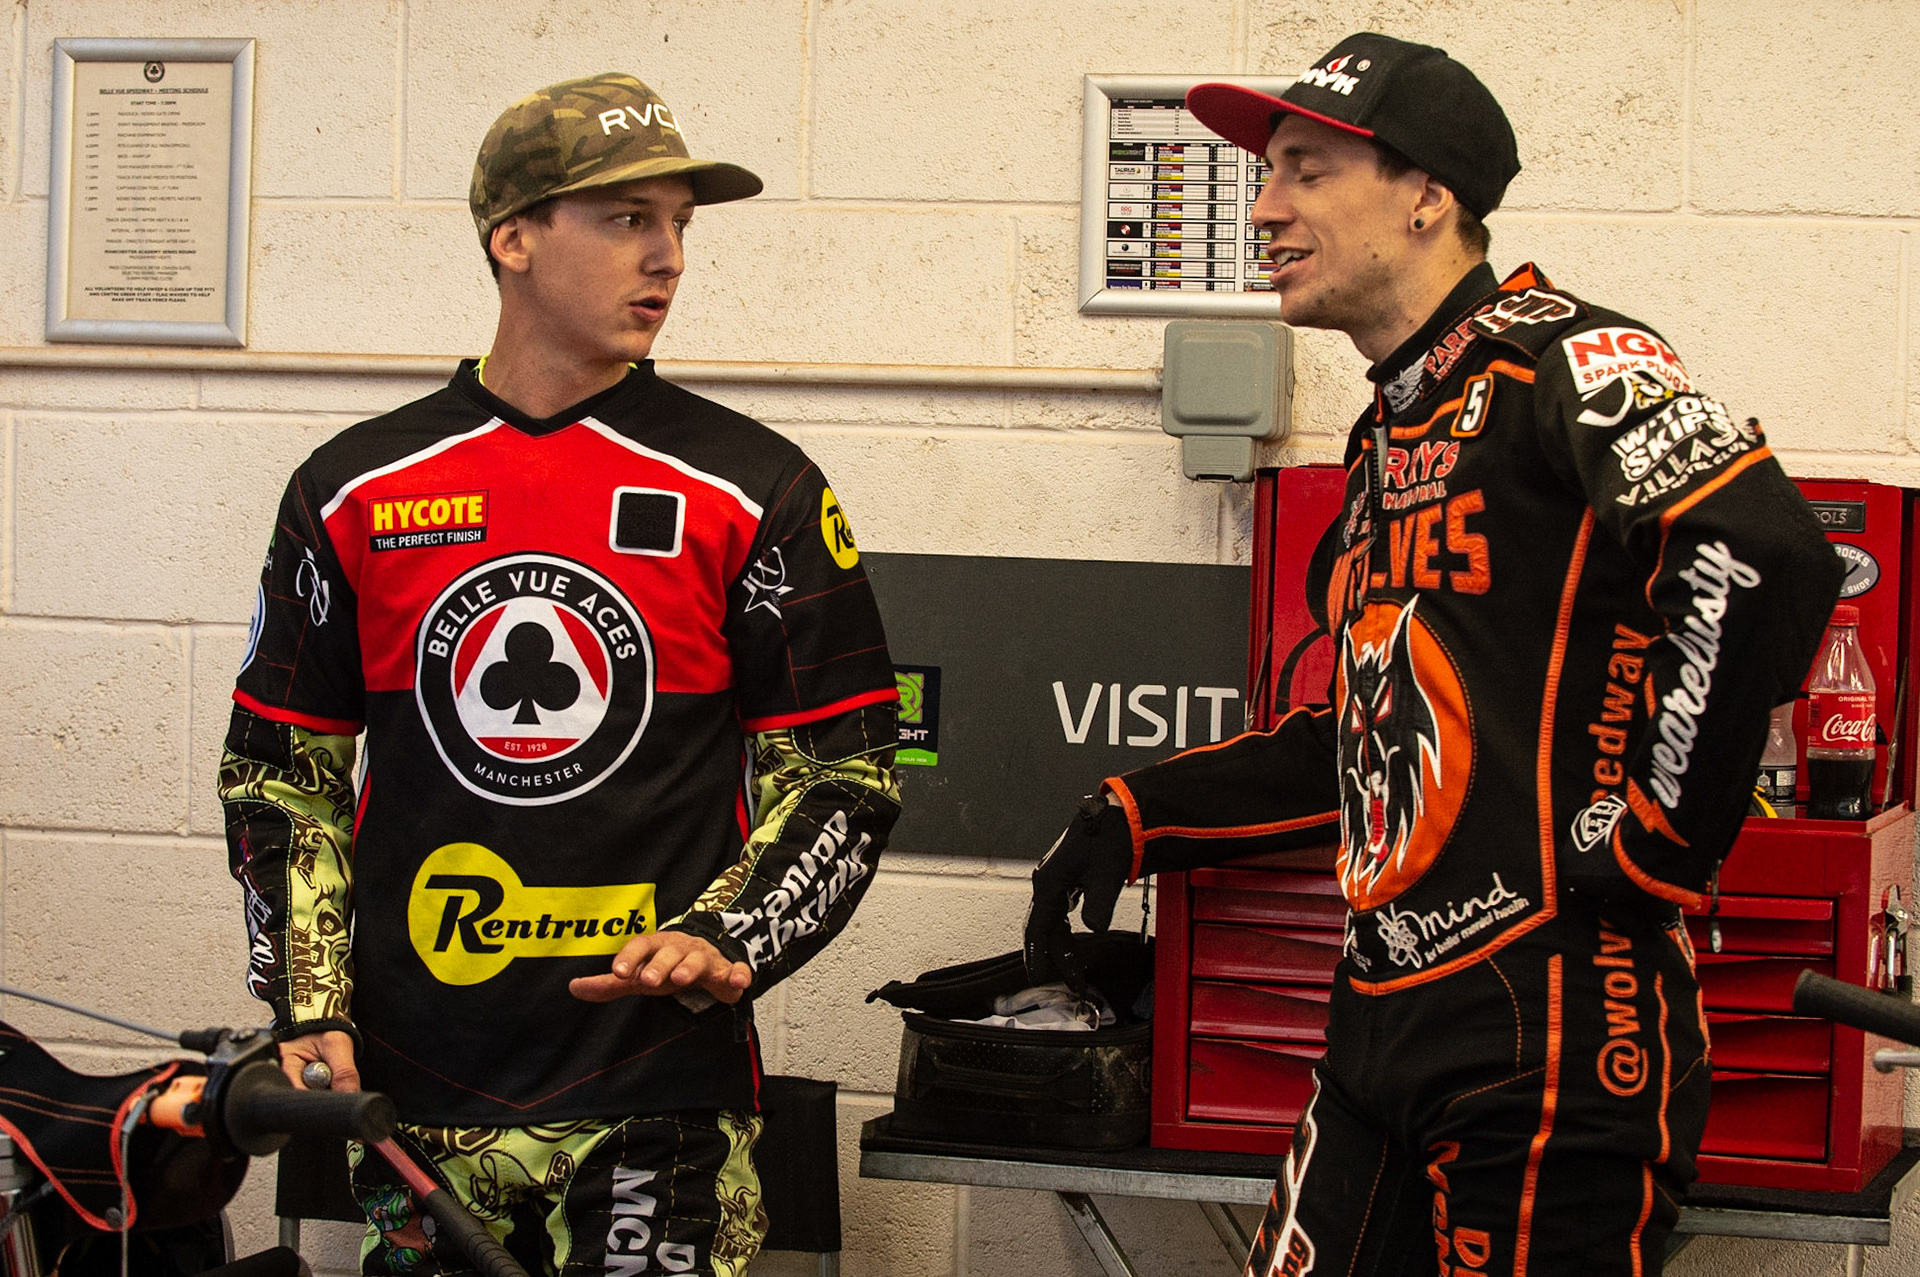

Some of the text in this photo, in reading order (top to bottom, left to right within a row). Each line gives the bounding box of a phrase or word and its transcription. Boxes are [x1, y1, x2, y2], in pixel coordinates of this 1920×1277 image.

[1583, 360, 1640, 384] SPARK
[1460, 380, 1487, 432] 5
[373, 495, 484, 531] HYCOTE
[376, 530, 481, 550] THE PERFECT FINISH
[1847, 578, 1871, 594] SHOP
[427, 570, 638, 660] BELLE VUE ACES
[1052, 680, 1240, 748] VISIT
[504, 741, 548, 753] EST. 1928
[474, 762, 584, 787] MANCHESTER
[424, 874, 647, 954] Rentruck
[1593, 918, 1648, 1097] @wolv
